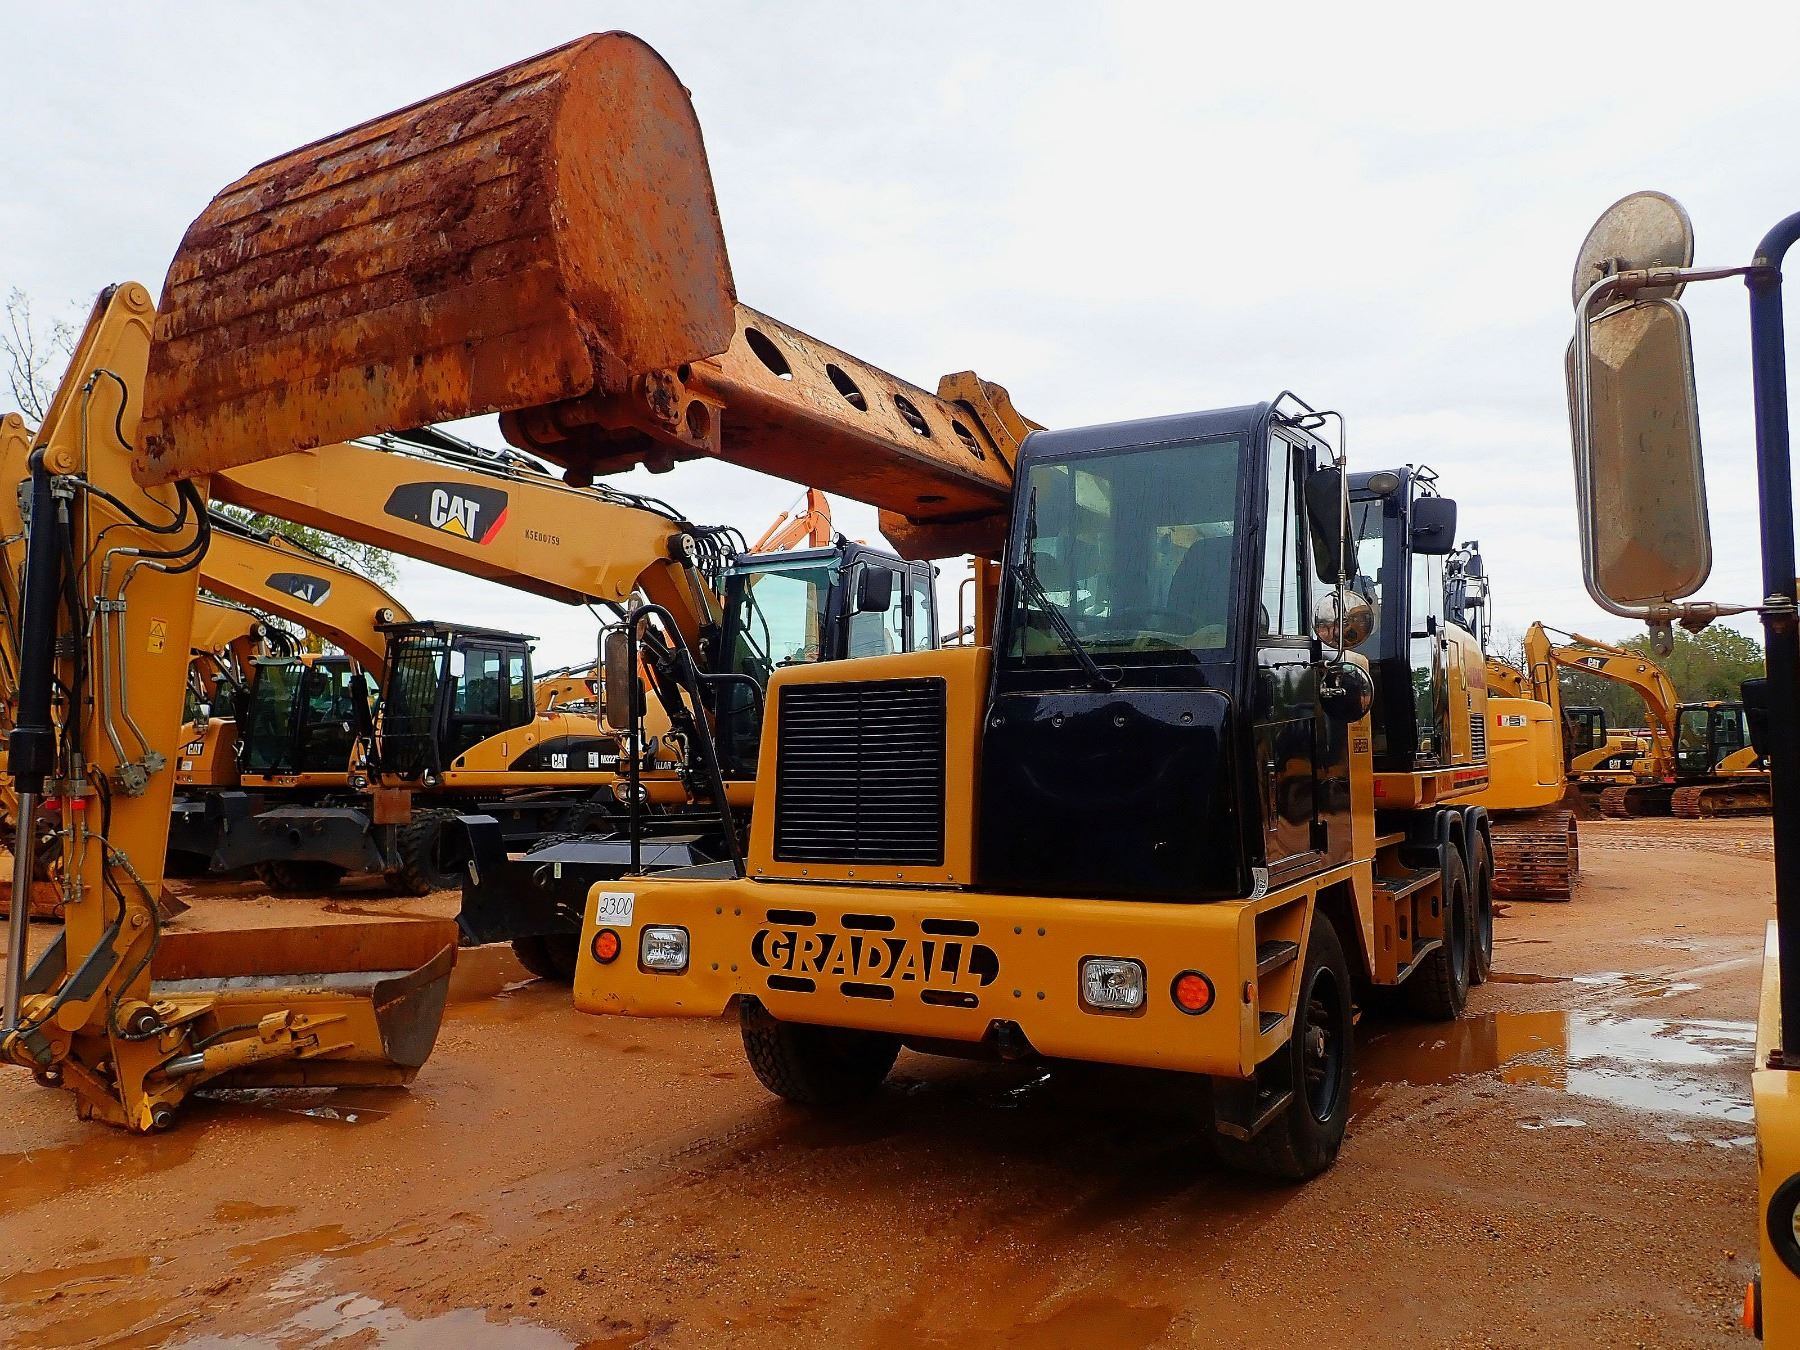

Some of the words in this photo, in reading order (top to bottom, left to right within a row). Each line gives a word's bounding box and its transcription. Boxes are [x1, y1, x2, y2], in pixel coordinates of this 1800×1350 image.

[429, 489, 480, 539] CAT
[187, 743, 203, 755] CAT
[551, 753, 568, 769] CAT
[1609, 759, 1621, 770] CAT
[599, 897, 632, 915] 2300
[760, 929, 983, 987] GRADALL
